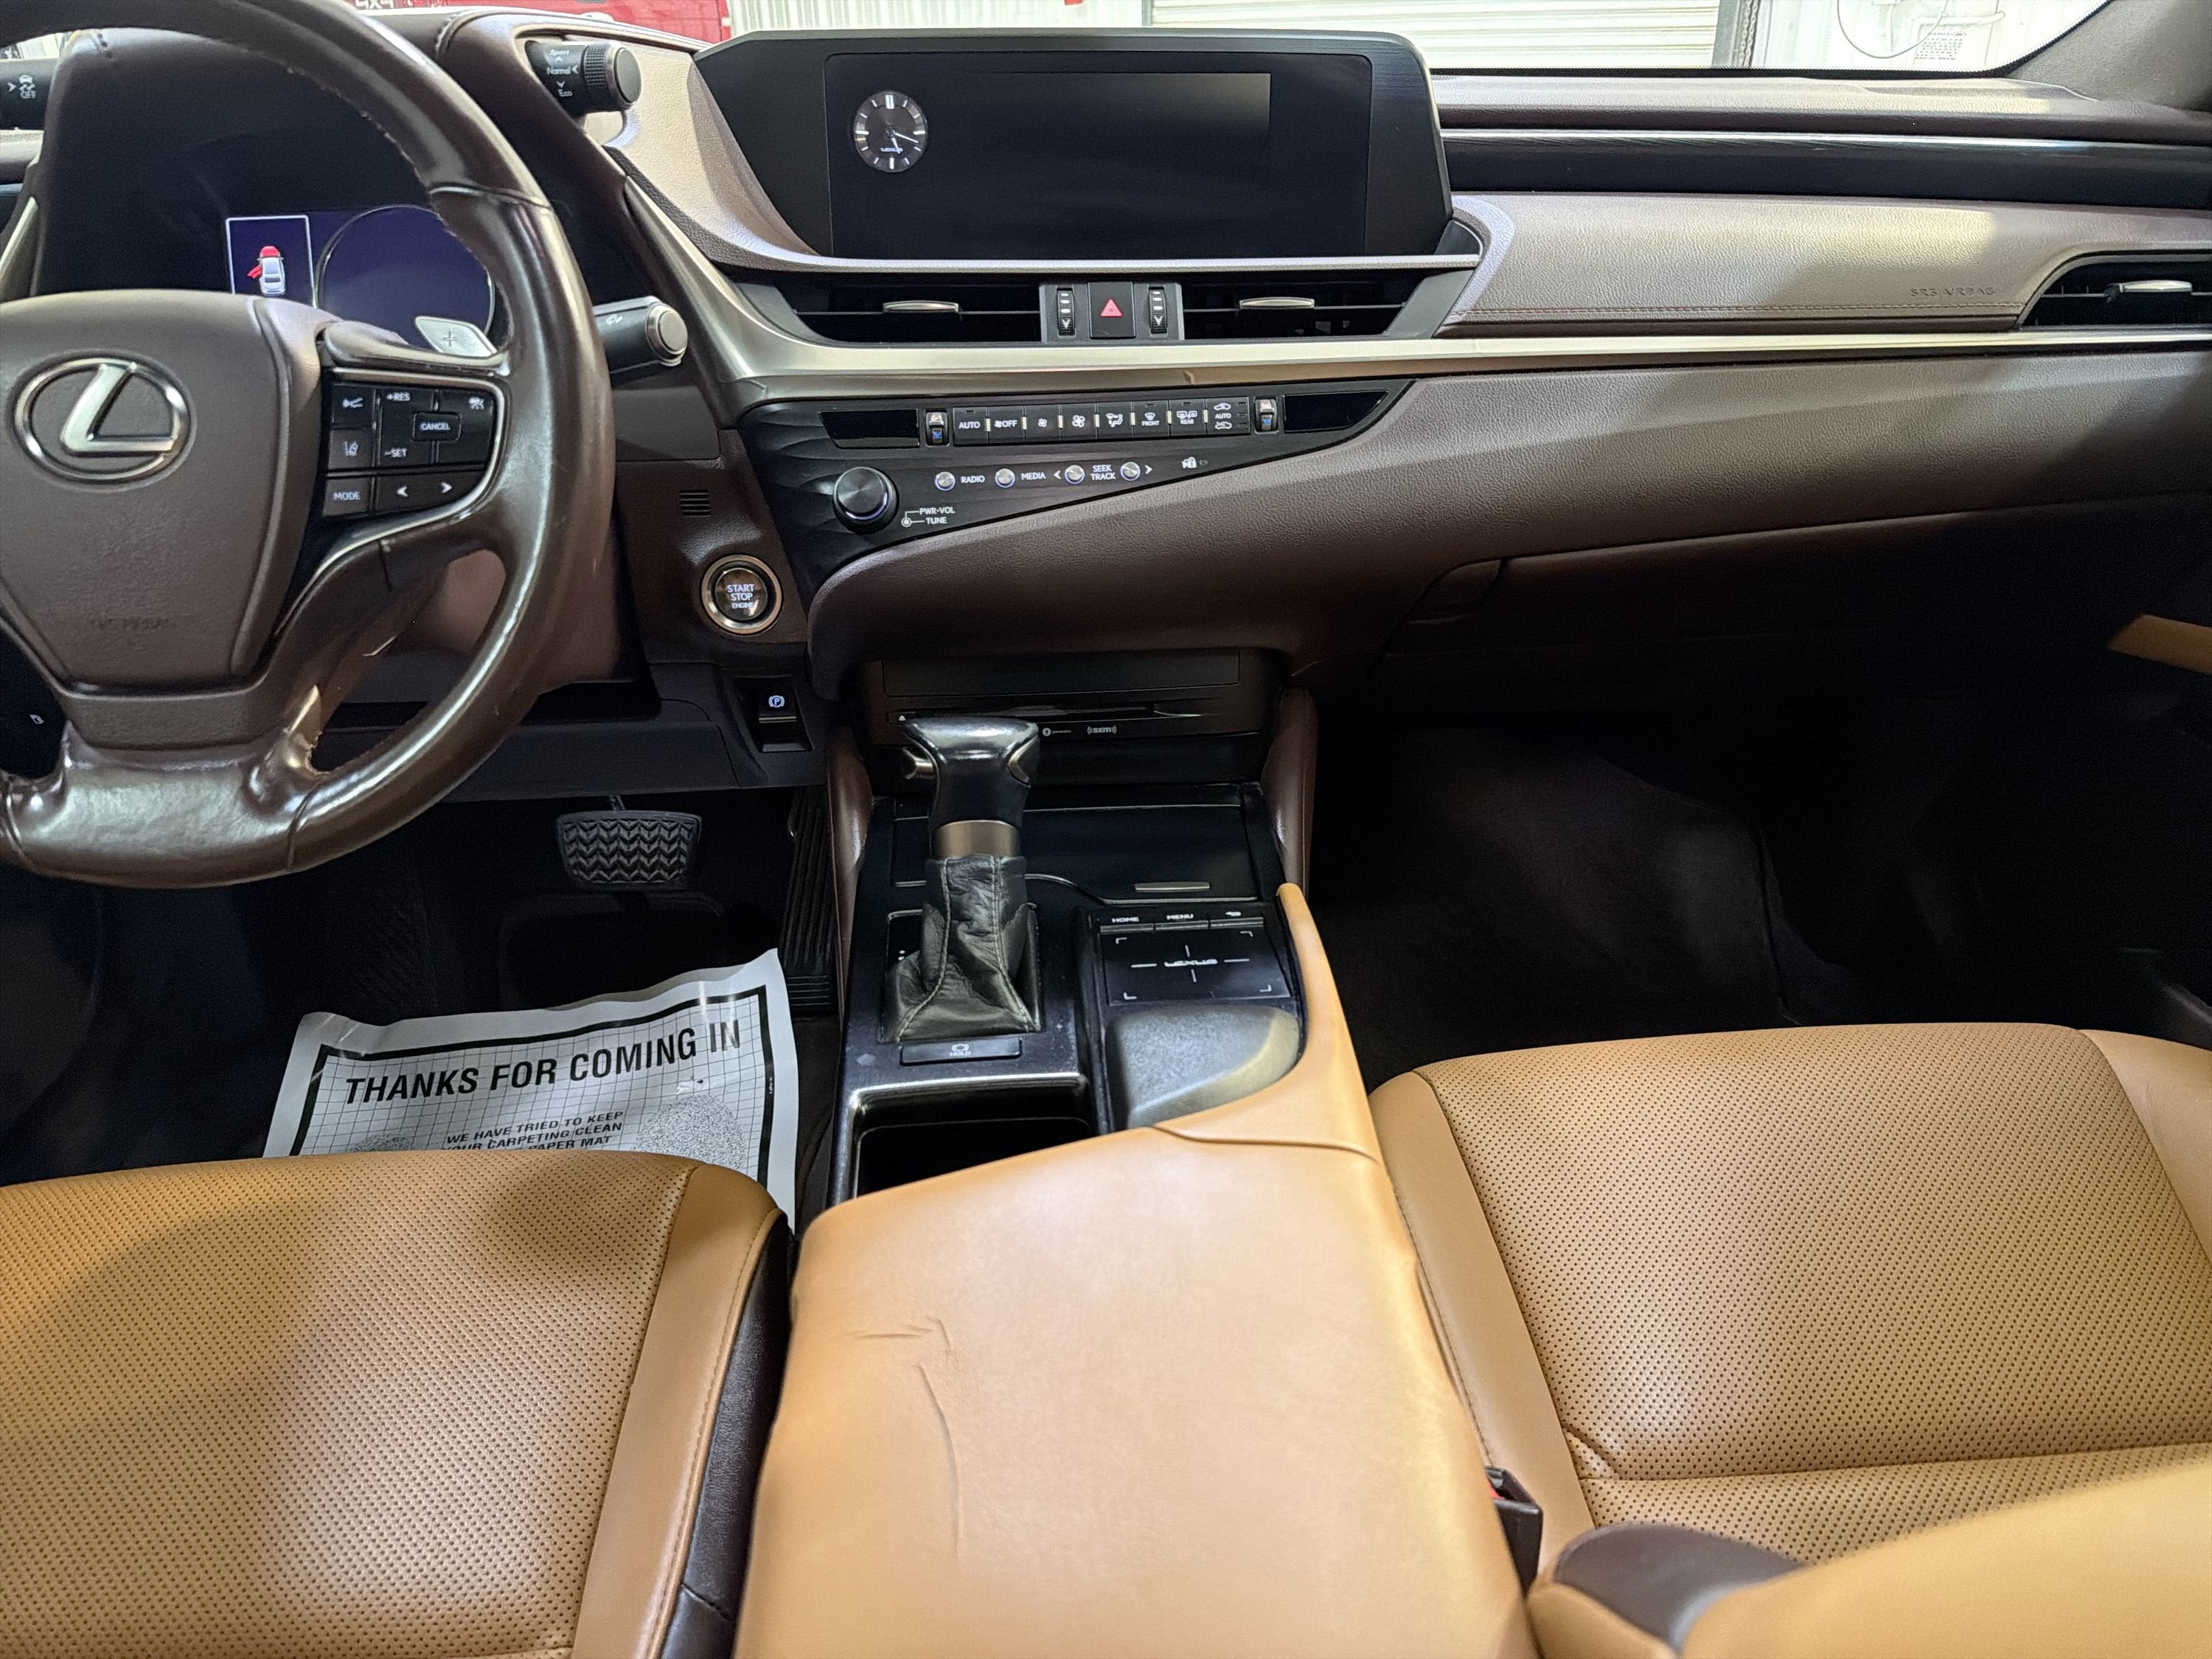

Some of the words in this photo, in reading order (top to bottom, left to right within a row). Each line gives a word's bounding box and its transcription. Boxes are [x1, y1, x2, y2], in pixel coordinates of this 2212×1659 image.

[547, 66, 571, 74] Normal
[558, 89, 573, 97] Eco
[420, 422, 451, 431] CANCEL
[959, 421, 981, 429] AUTO
[1092, 465, 1112, 473] SEEK
[961, 475, 986, 484] RADIO
[1021, 472, 1046, 480] MEDIA
[1090, 472, 1116, 481] TRACK
[333, 492, 361, 501] MODE
[925, 517, 947, 525] TUNE
[727, 584, 755, 593] START
[731, 592, 754, 601] STOP
[1164, 959, 1218, 967] LEXUS
[346, 1068, 479, 1105] THANKS
[490, 1059, 557, 1090] FOR
[570, 1027, 696, 1081] COMING
[708, 1019, 741, 1053] IN
[447, 1133, 470, 1144] WE
[474, 1127, 512, 1139] HAVE
[517, 1120, 558, 1133] TRIED
[565, 1117, 582, 1127] TO
[588, 1111, 624, 1124] KEEP
[487, 1130, 570, 1150] CARPETING
[575, 1122, 622, 1135] CLEAN
[580, 1135, 613, 1147] MAT
